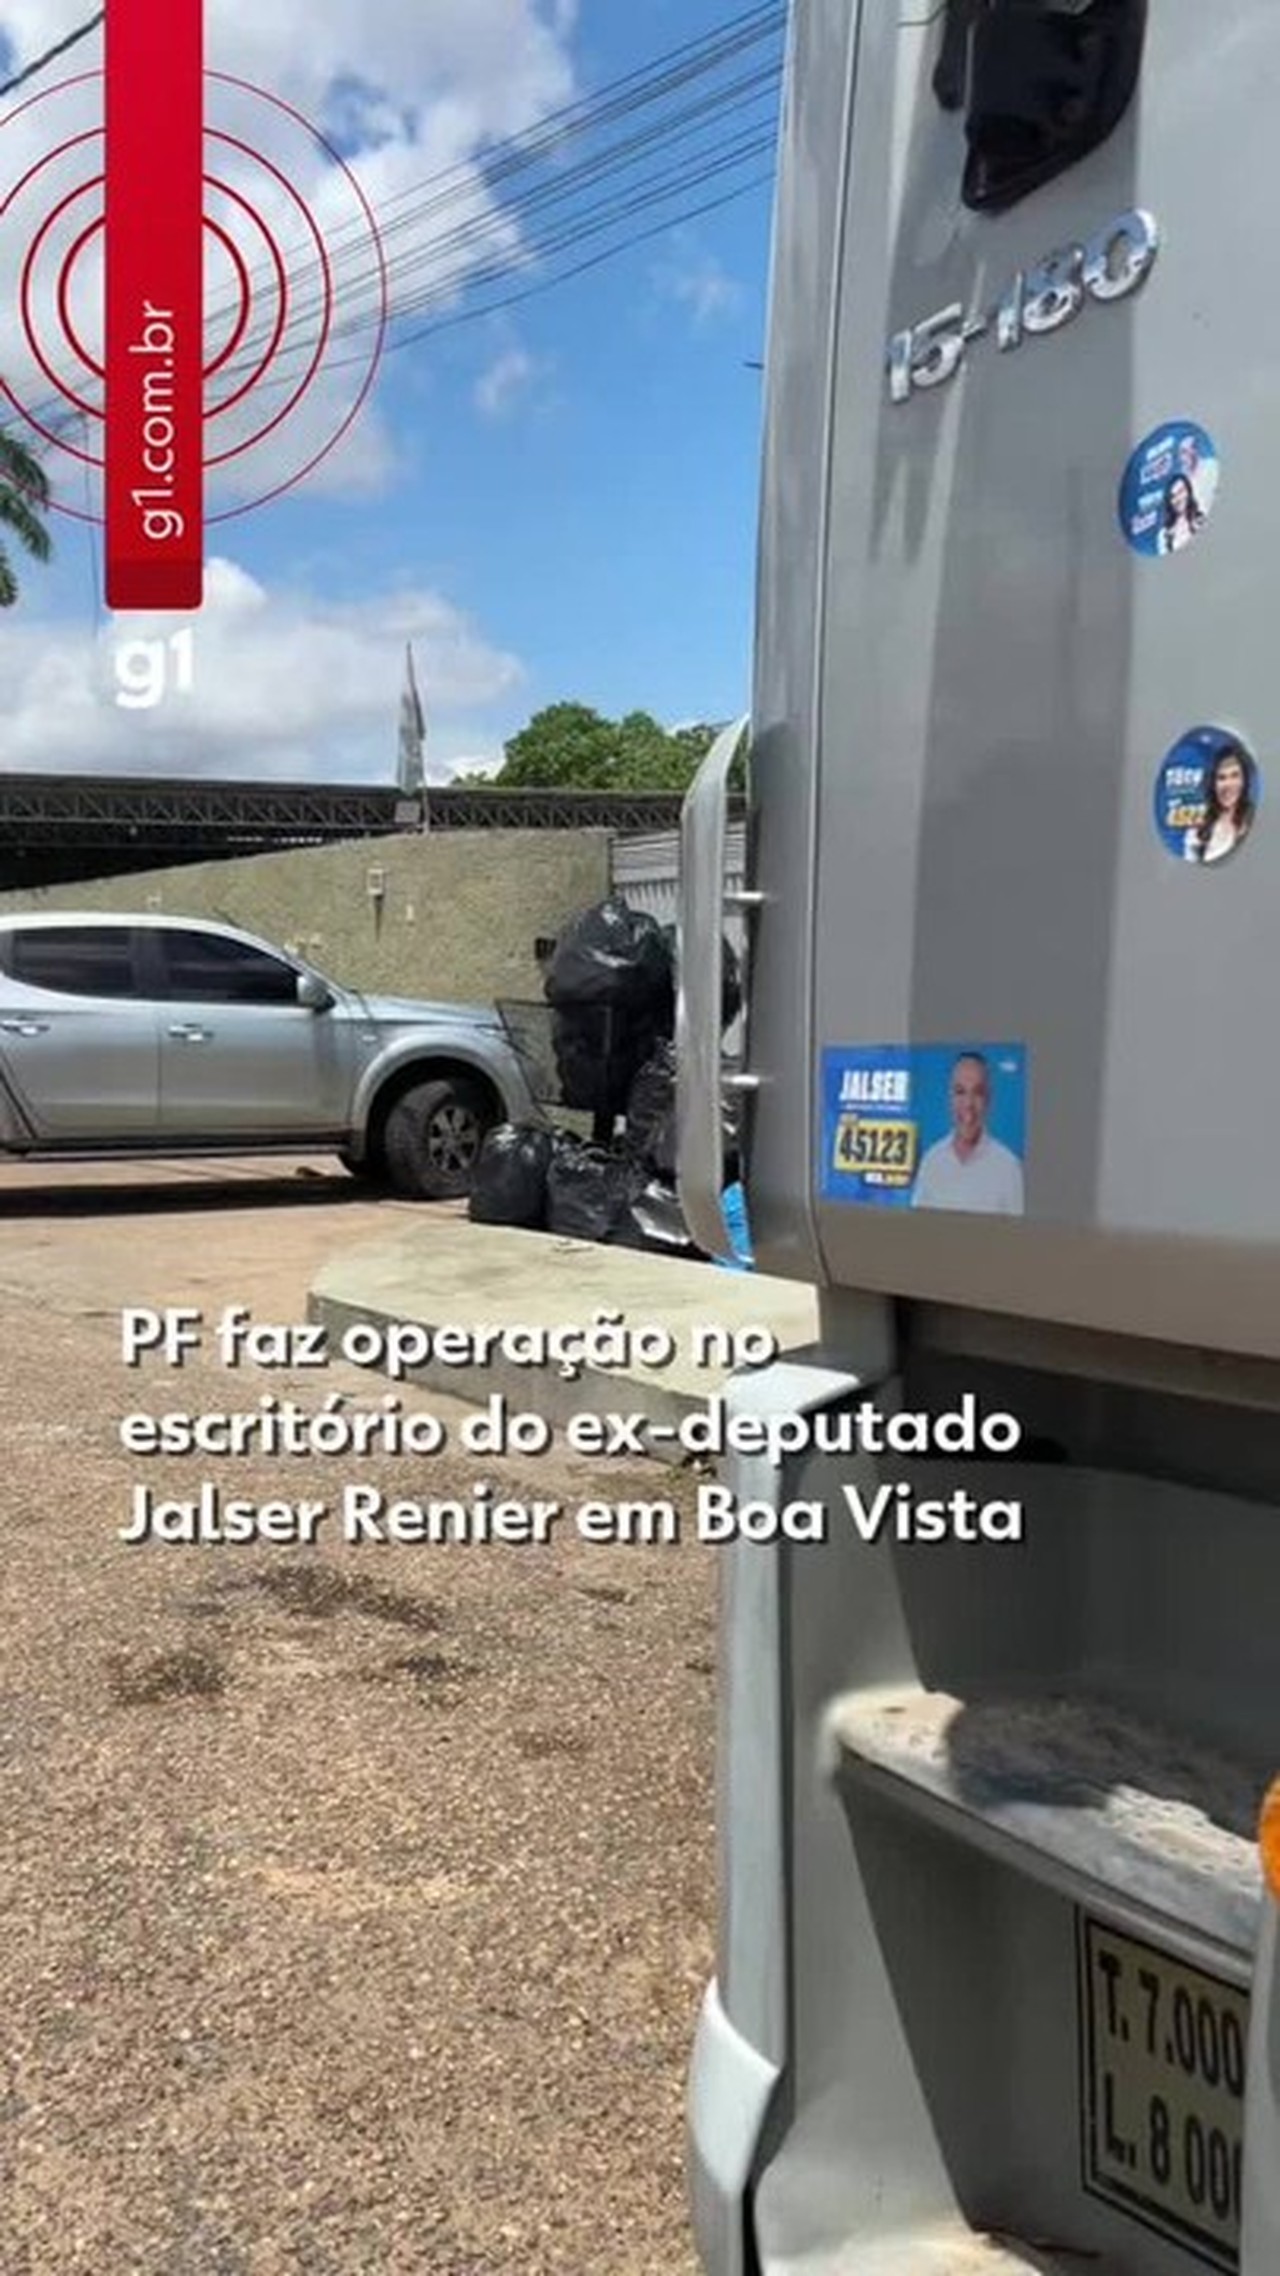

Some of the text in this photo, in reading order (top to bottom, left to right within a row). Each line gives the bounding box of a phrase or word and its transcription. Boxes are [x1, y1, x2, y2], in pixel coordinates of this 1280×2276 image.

[887, 208, 1158, 402] 15-180
[839, 1127, 909, 1166] 45123
[1100, 1949, 1245, 2098] T. 7.000
